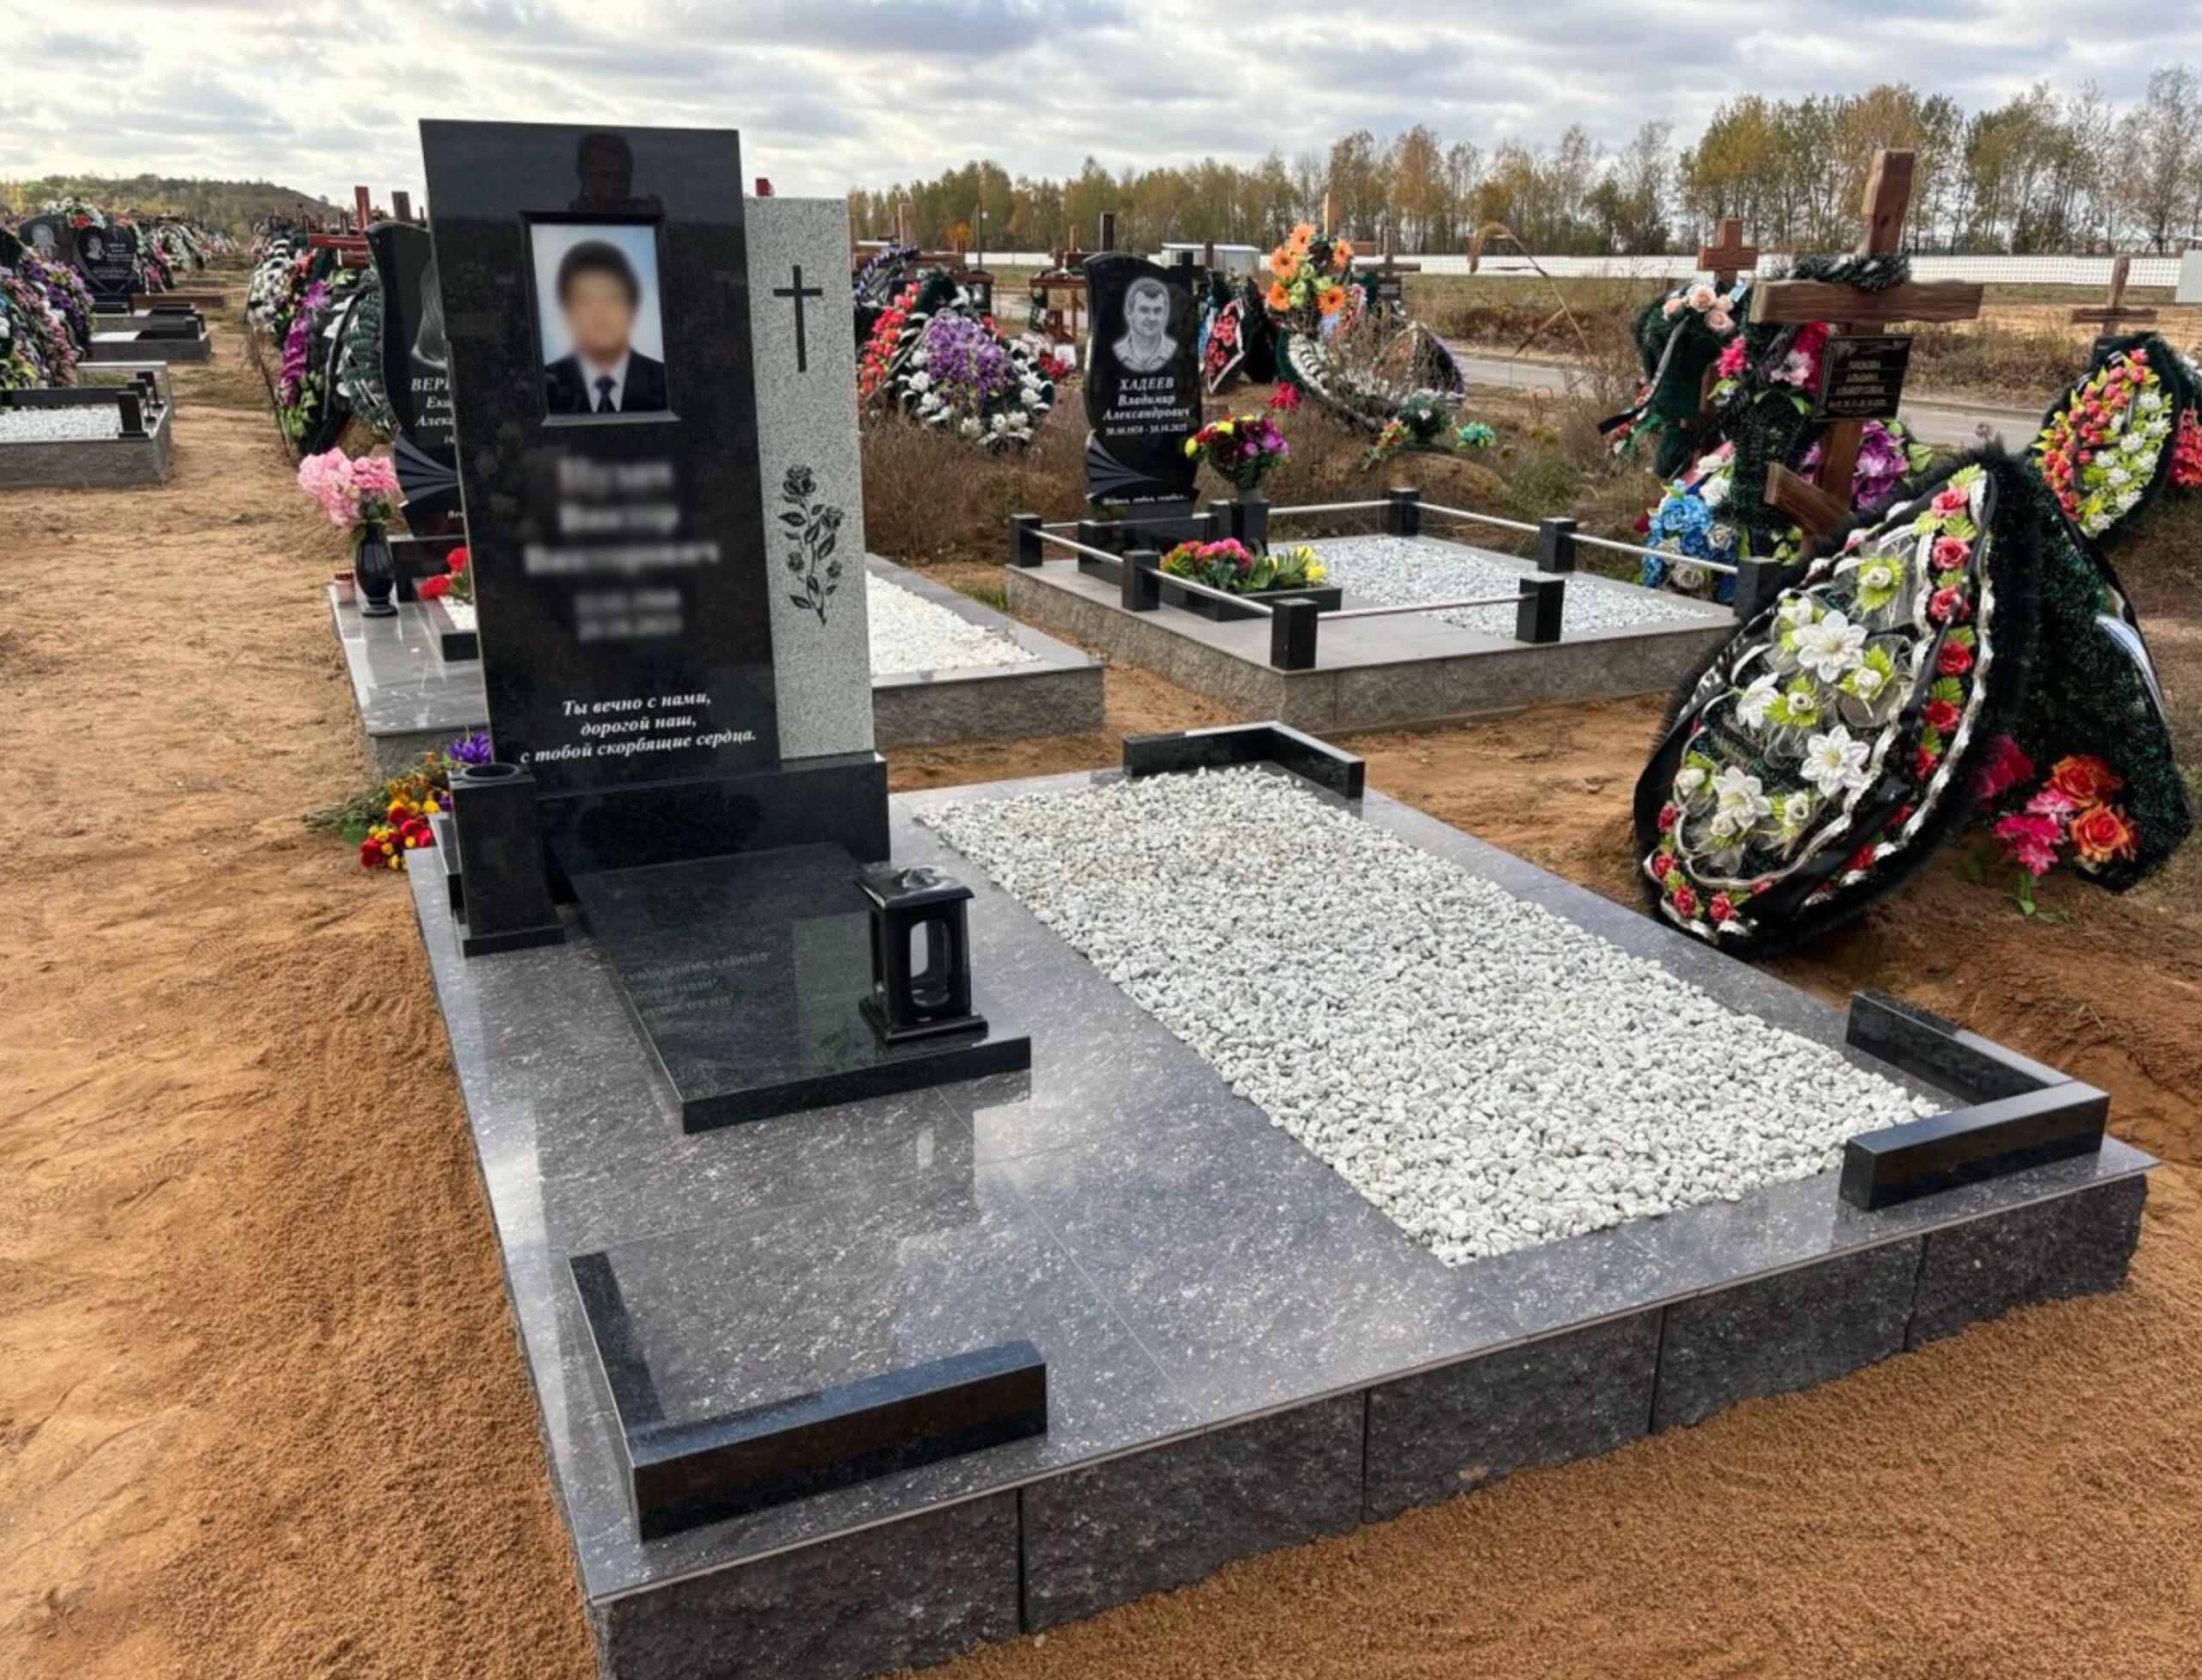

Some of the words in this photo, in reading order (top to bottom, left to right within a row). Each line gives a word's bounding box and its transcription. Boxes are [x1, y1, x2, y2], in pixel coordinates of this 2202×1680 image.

[1120, 377, 1174, 391] ХАДЕЕВ
[1118, 393, 1176, 406] Владимир
[1103, 407, 1190, 420] Александрович
[563, 699, 587, 716] Ты
[592, 698, 643, 713] вечно
[646, 698, 656, 709] с
[661, 693, 711, 707] нами,
[580, 716, 649, 738] дорогой
[655, 715, 698, 729] наш,
[520, 752, 530, 764] с
[534, 742, 593, 762] тобой
[596, 737, 692, 758] скорбящие
[695, 728, 757, 749] сердца.
